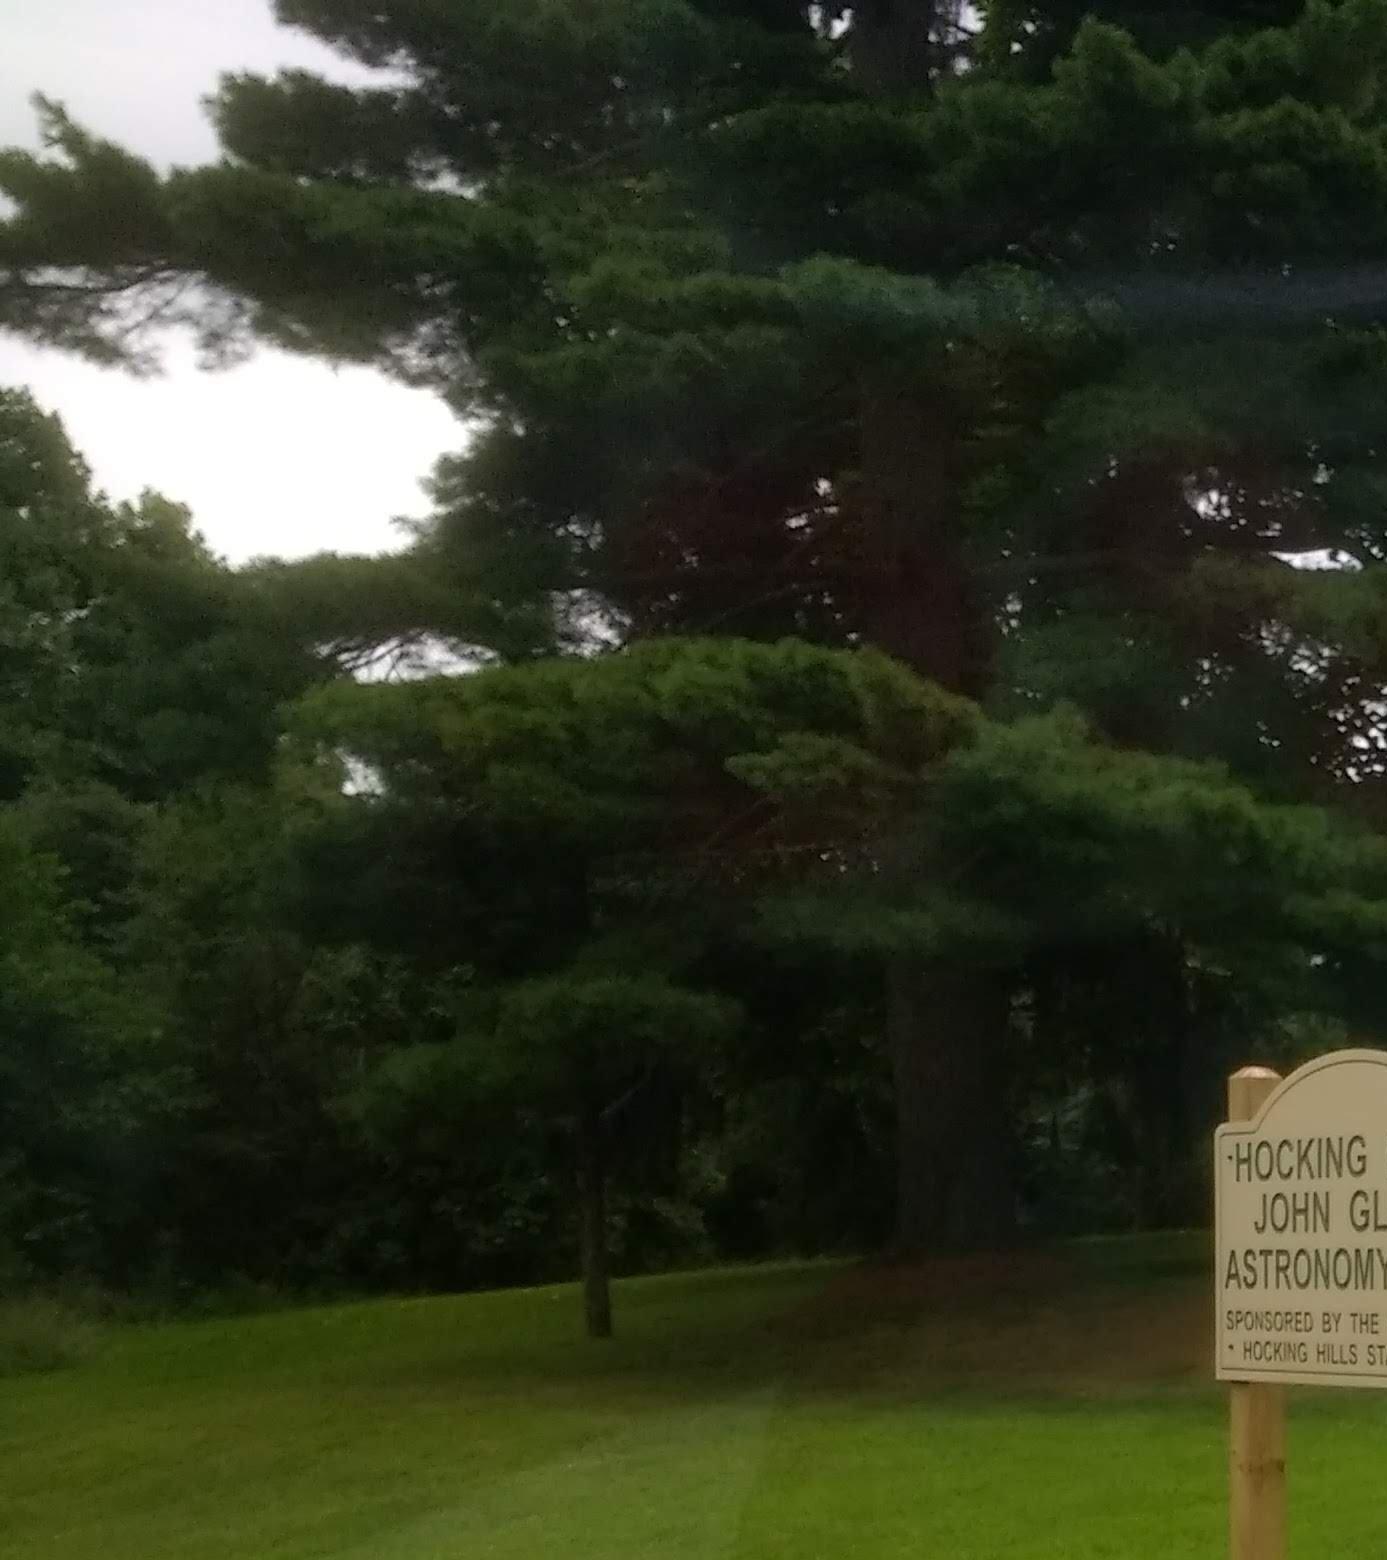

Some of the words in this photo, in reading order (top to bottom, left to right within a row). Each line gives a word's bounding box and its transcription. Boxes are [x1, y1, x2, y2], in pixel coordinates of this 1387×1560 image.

[1234, 1135, 1367, 1182] HOCKING
[1254, 1191, 1330, 1234] JOHN
[1226, 1310, 1313, 1333] SPONSORED
[1322, 1312, 1342, 1333] BY
[1350, 1313, 1379, 1335] THE
[1243, 1341, 1308, 1363] HOCKING
[1316, 1344, 1358, 1365] HILLS
